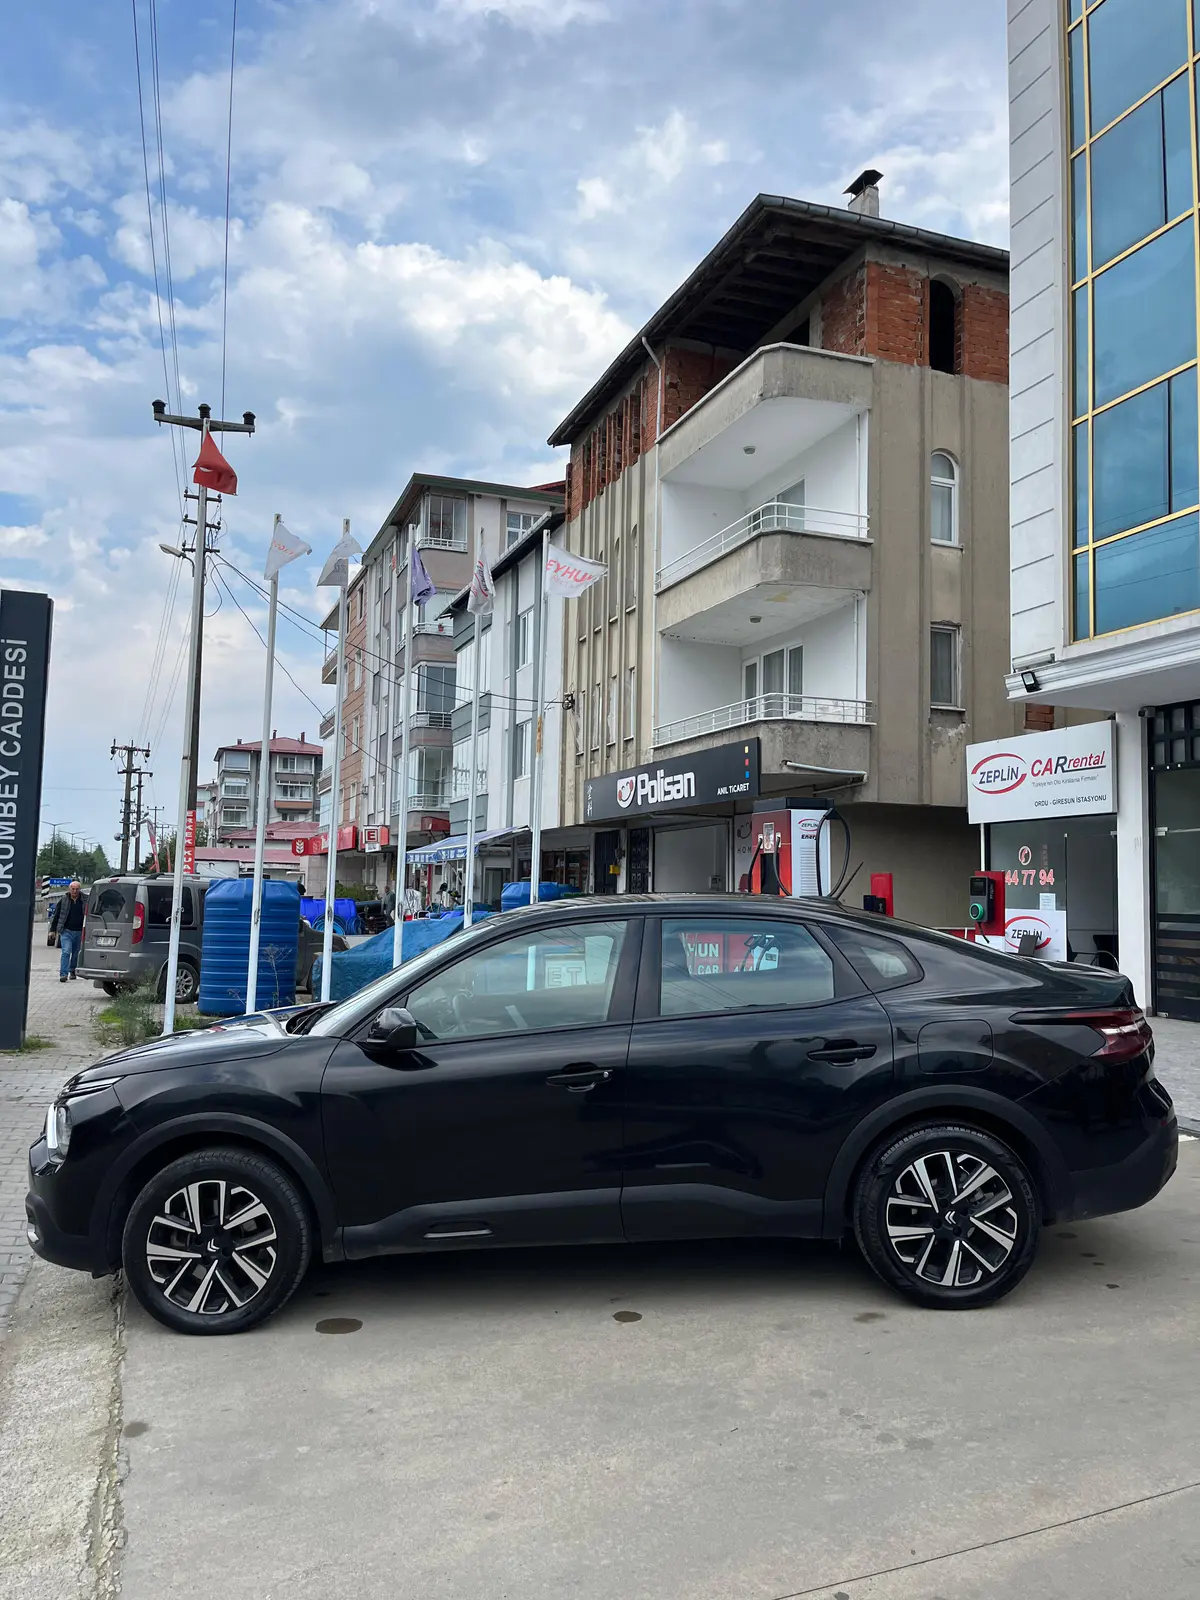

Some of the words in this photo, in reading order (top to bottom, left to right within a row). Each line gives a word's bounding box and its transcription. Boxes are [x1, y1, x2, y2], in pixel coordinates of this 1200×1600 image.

[0, 638, 27, 757] CADDESİ
[979, 766, 1019, 784] ZEPLİN
[637, 769, 696, 806] Polisan
[717, 787, 728, 796] ANIL
[1076, 795, 1107, 803] İSTASYONU
[367, 831, 376, 841] E
[1003, 869, 1019, 886] 44
[1021, 869, 1036, 886] 77
[1039, 868, 1055, 886] 94
